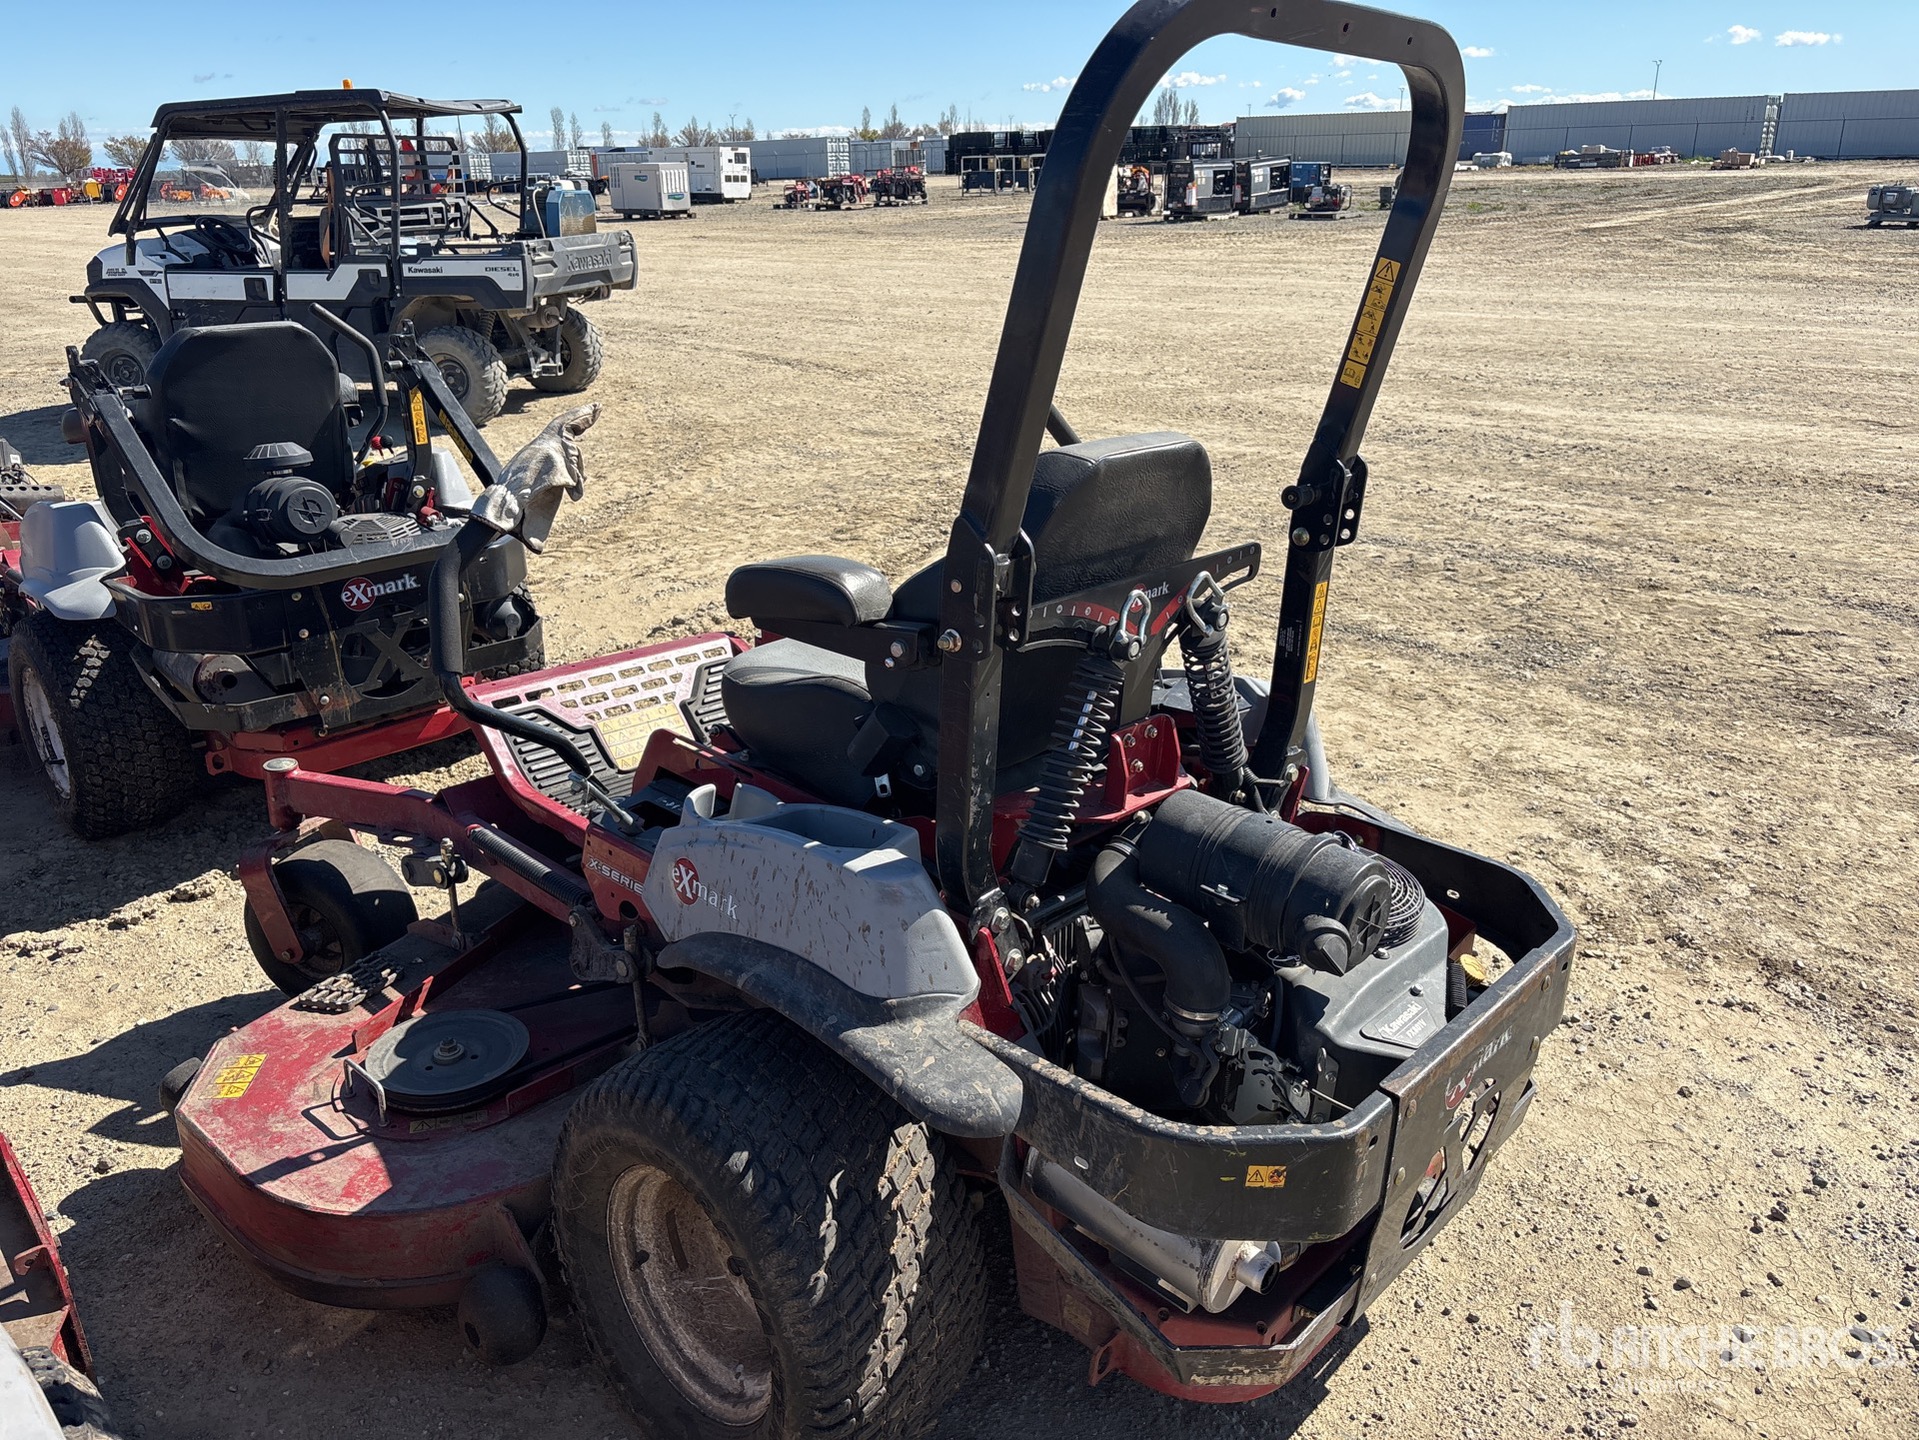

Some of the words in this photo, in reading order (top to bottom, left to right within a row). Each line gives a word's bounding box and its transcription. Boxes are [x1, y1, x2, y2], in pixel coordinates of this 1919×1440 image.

[407, 266, 443, 274] Kawasaki
[566, 249, 612, 272] Kawasaki
[340, 573, 419, 607] eXmark
[586, 855, 644, 896] X-SERIE
[671, 864, 738, 920] eXmark
[1379, 1000, 1423, 1036] Kawasaki
